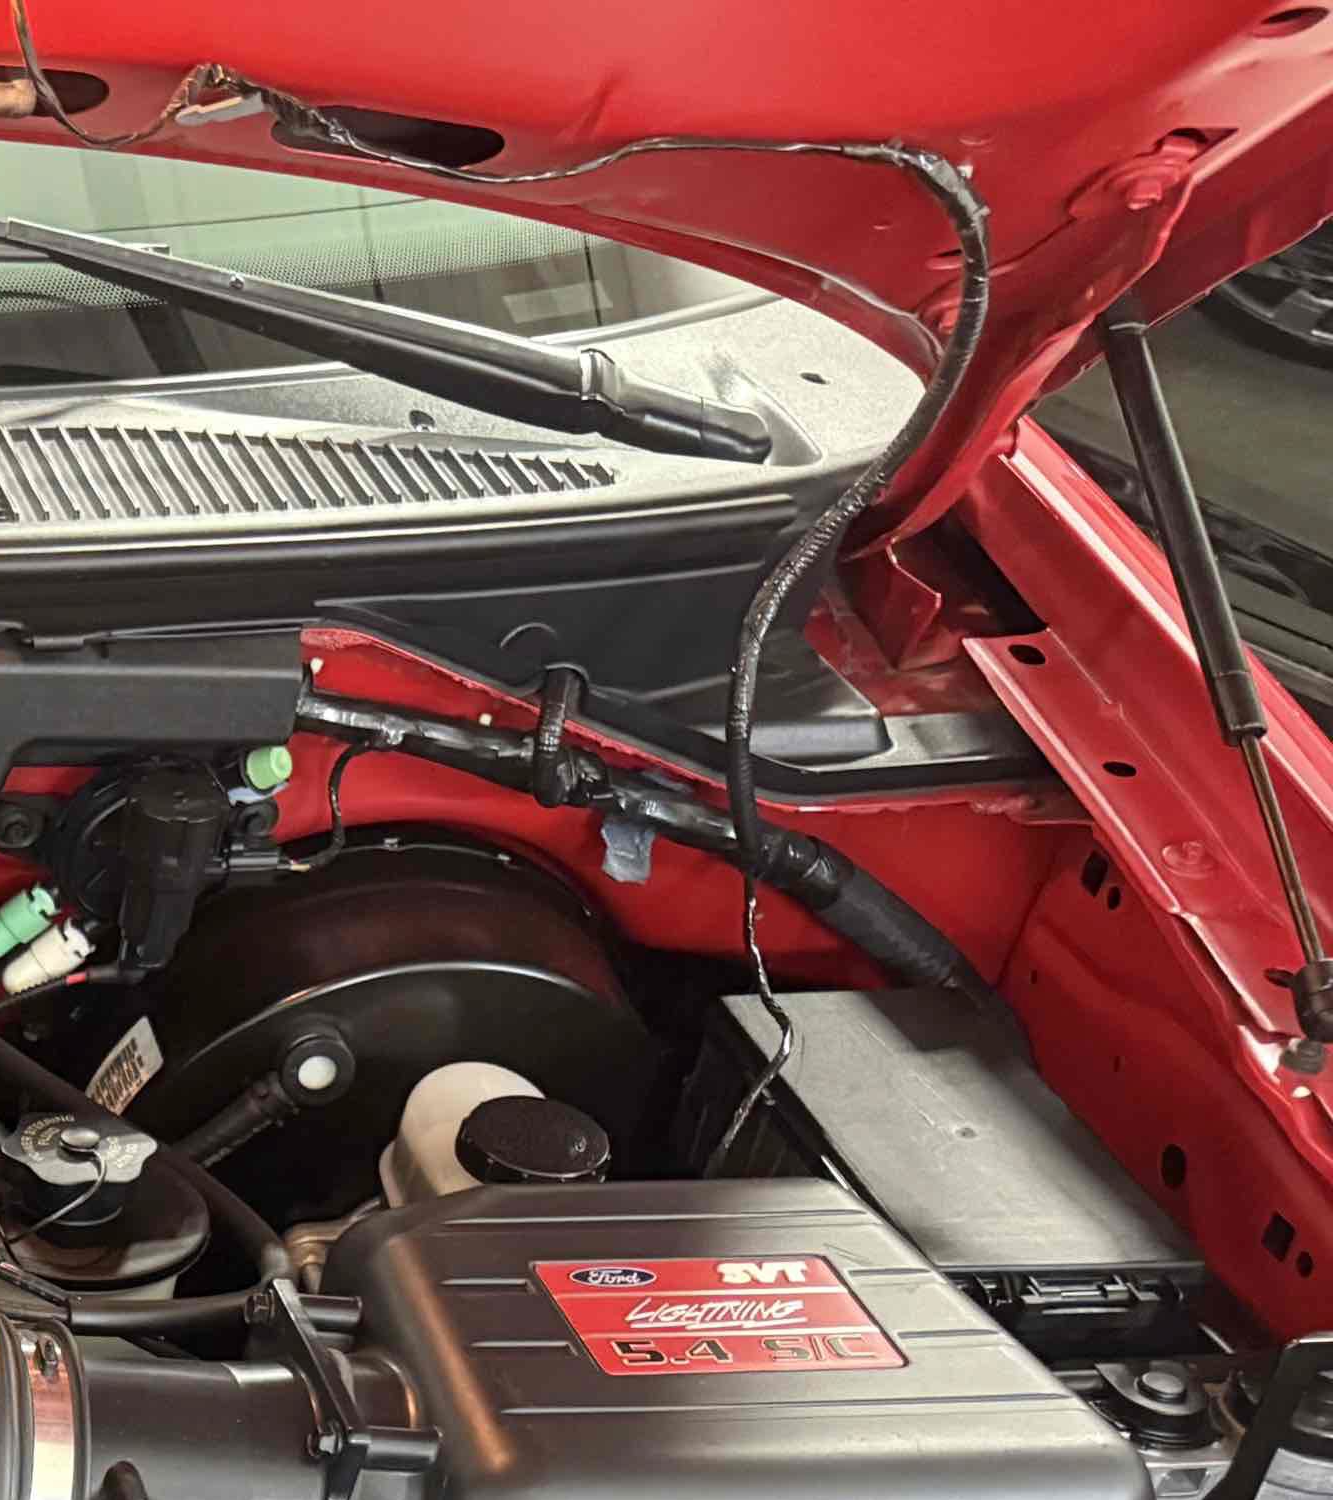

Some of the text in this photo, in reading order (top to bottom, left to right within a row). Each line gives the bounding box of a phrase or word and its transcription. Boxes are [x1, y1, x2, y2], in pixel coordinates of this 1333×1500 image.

[588, 1262, 806, 1287] Ford SVT
[611, 1338, 733, 1366] 5.4
